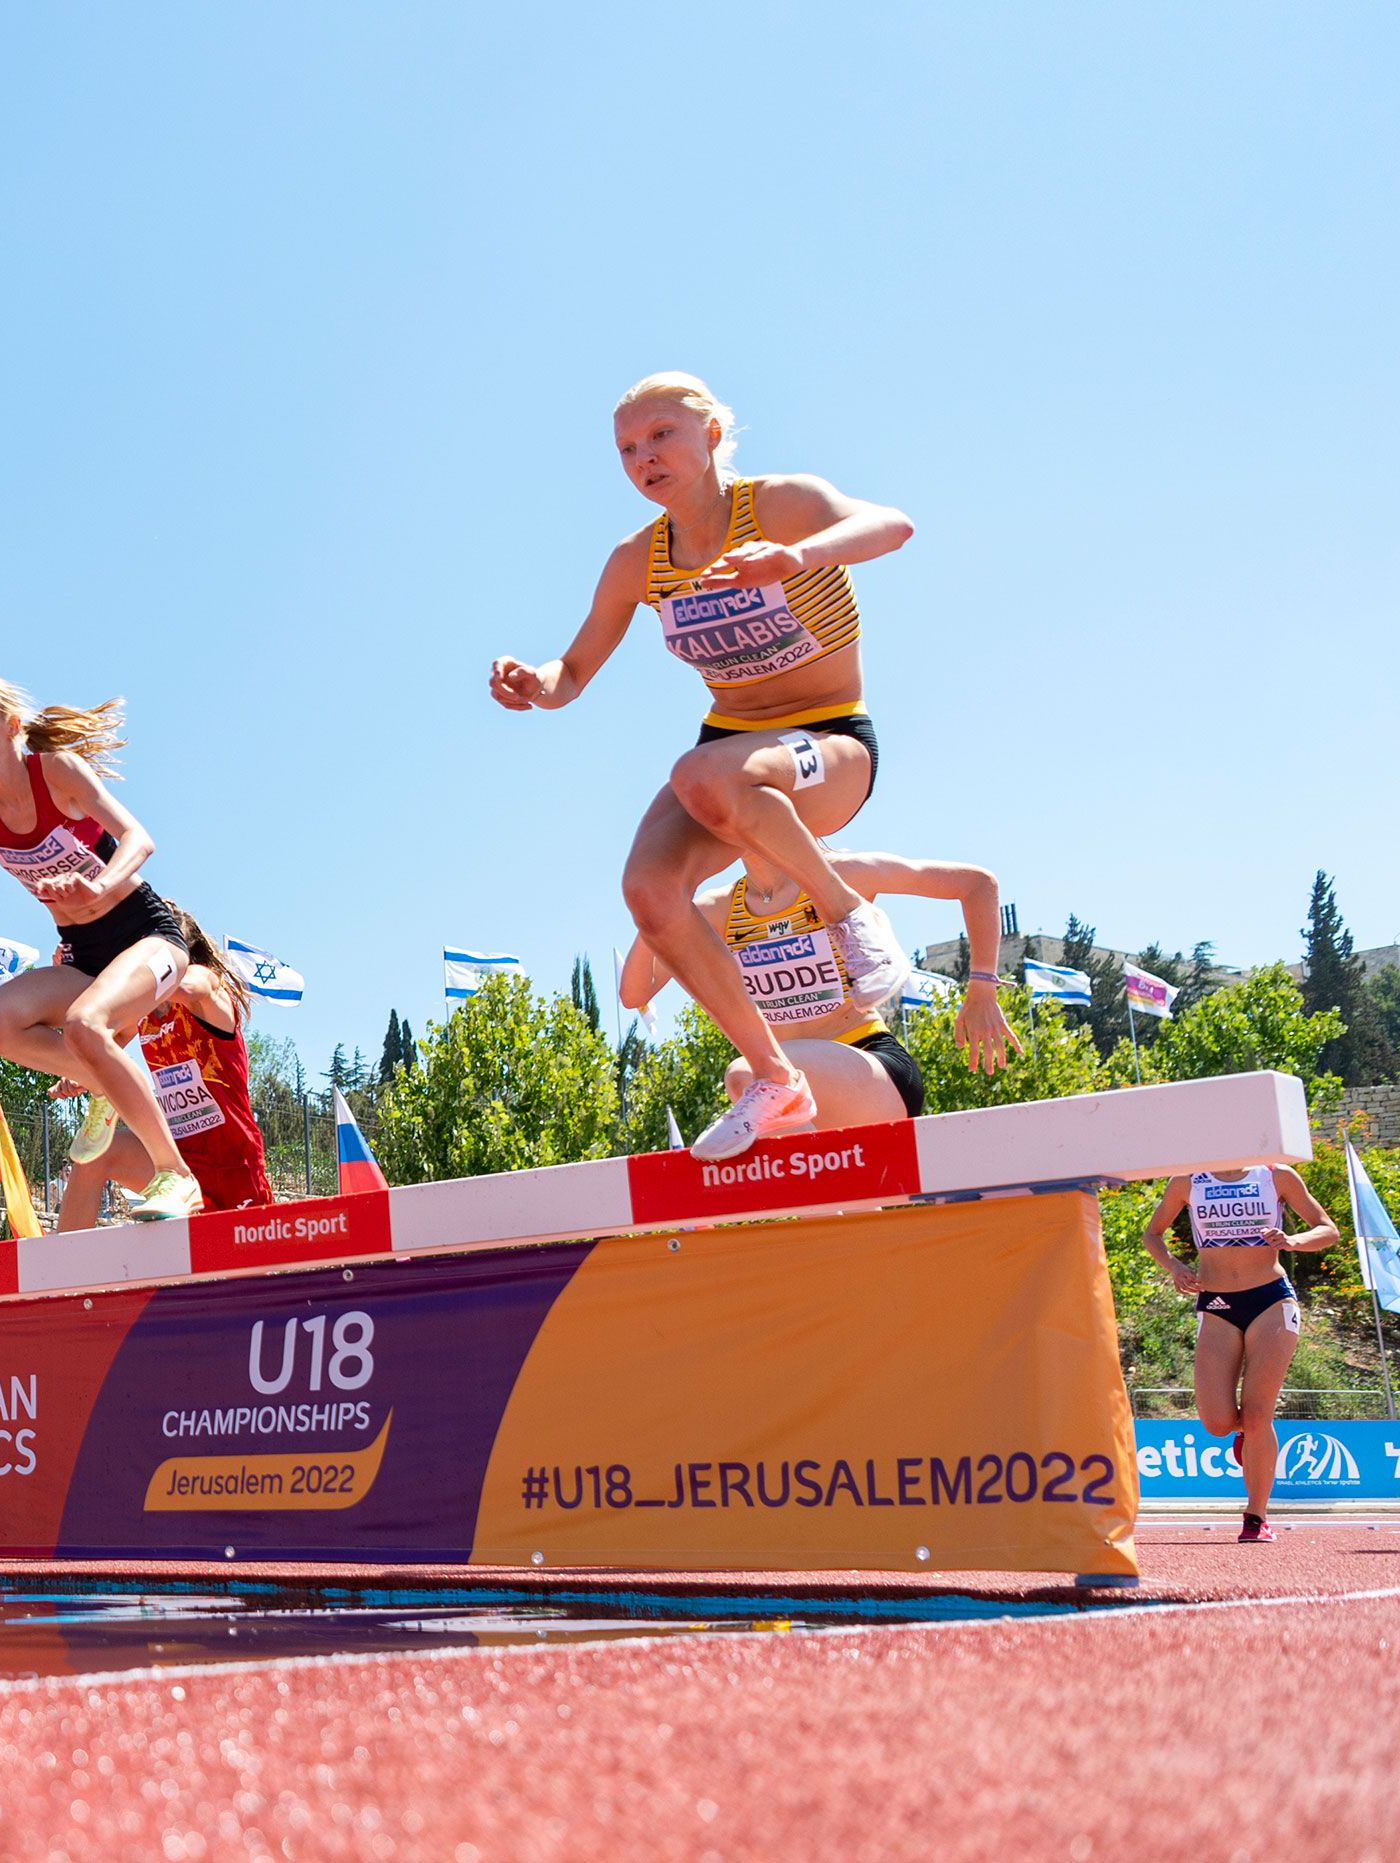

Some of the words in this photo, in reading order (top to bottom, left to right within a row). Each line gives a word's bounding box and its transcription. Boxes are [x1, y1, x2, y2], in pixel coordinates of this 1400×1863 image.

[668, 612, 798, 660] KALLABIS
[713, 656, 739, 670] RUN
[739, 646, 777, 664] CLEAN
[776, 641, 814, 668] 2022
[794, 738, 818, 780] 13
[766, 998, 786, 1008] RUN
[787, 993, 819, 1005] CLEAN
[200, 1114, 222, 1128] 2022
[790, 1143, 865, 1180] Sport
[1196, 1201, 1272, 1219] BAUGUIL
[294, 1213, 348, 1240] Sport
[1205, 1228, 1249, 1237] JERUSALEM
[247, 1310, 375, 1395] U18
[161, 1401, 371, 1438] CHAMPIONSHIPS
[1137, 1433, 1243, 1478] etics
[166, 1467, 285, 1497] Jerusalem
[290, 1465, 356, 1494] 2022
[521, 1451, 1116, 1510] #U18_JERUSALEM2022
